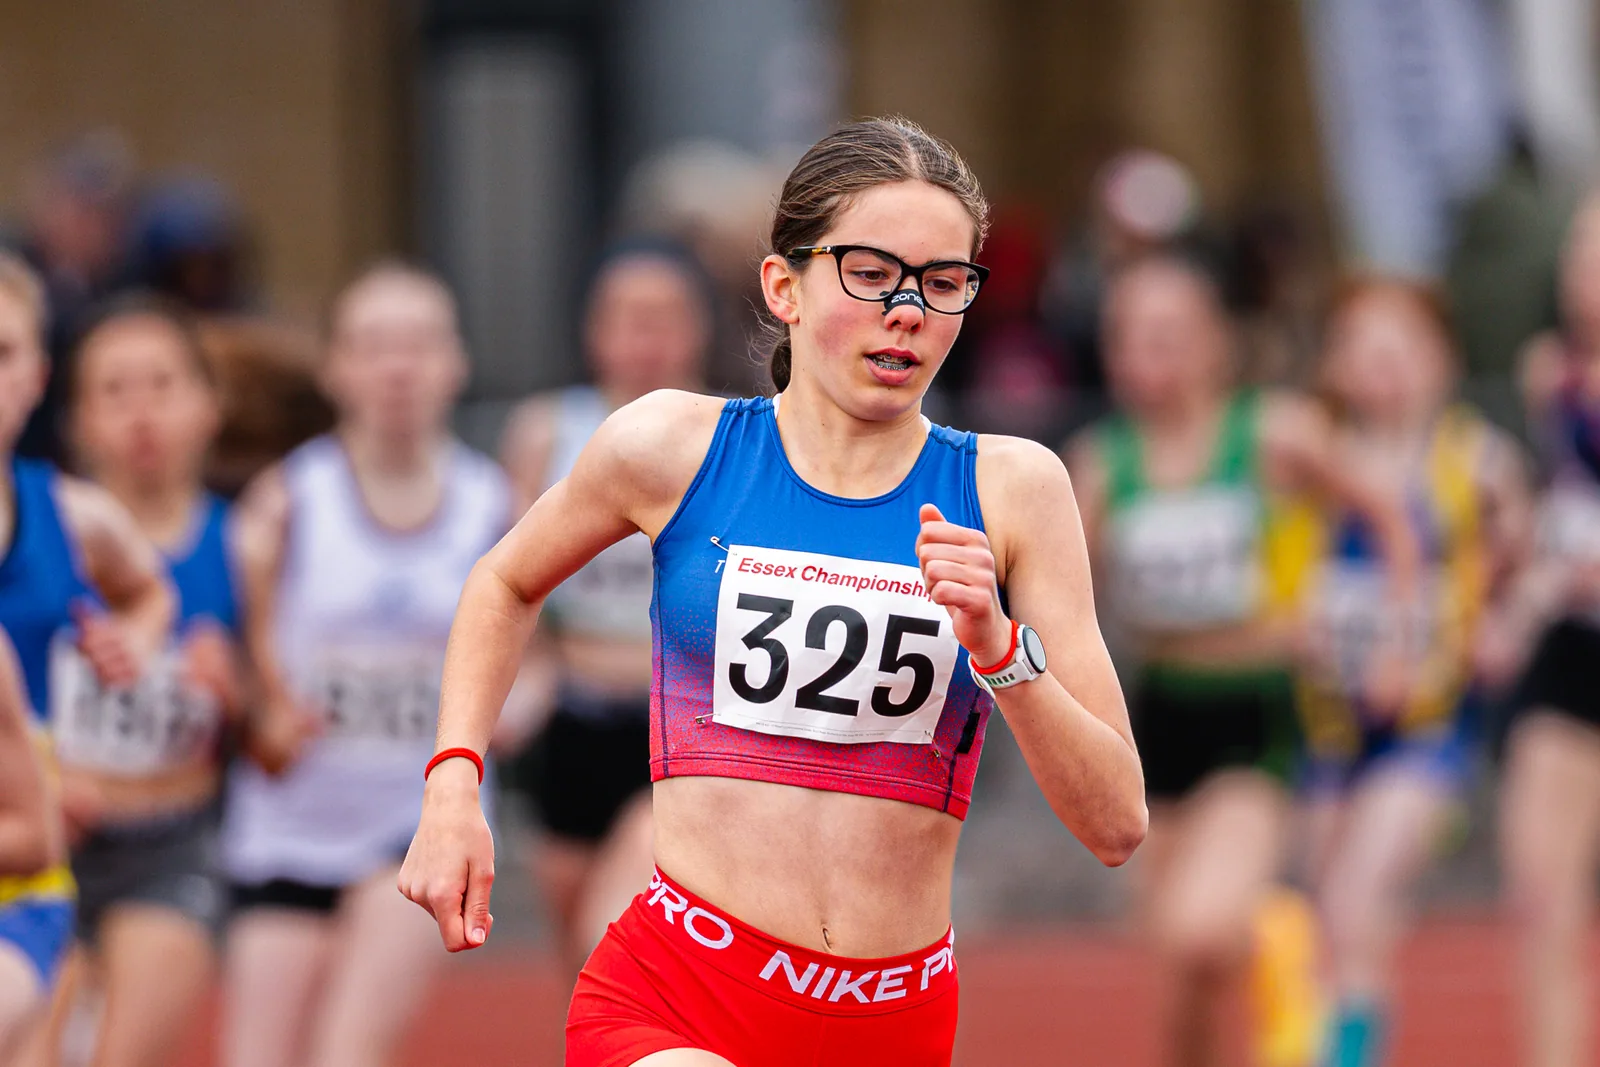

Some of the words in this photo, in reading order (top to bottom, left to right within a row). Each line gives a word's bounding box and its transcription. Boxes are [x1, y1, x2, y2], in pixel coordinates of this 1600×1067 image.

[738, 557, 798, 579] Essex
[801, 565, 932, 603] Championsh
[729, 592, 941, 717] 325
[758, 950, 912, 1003] NIKE
